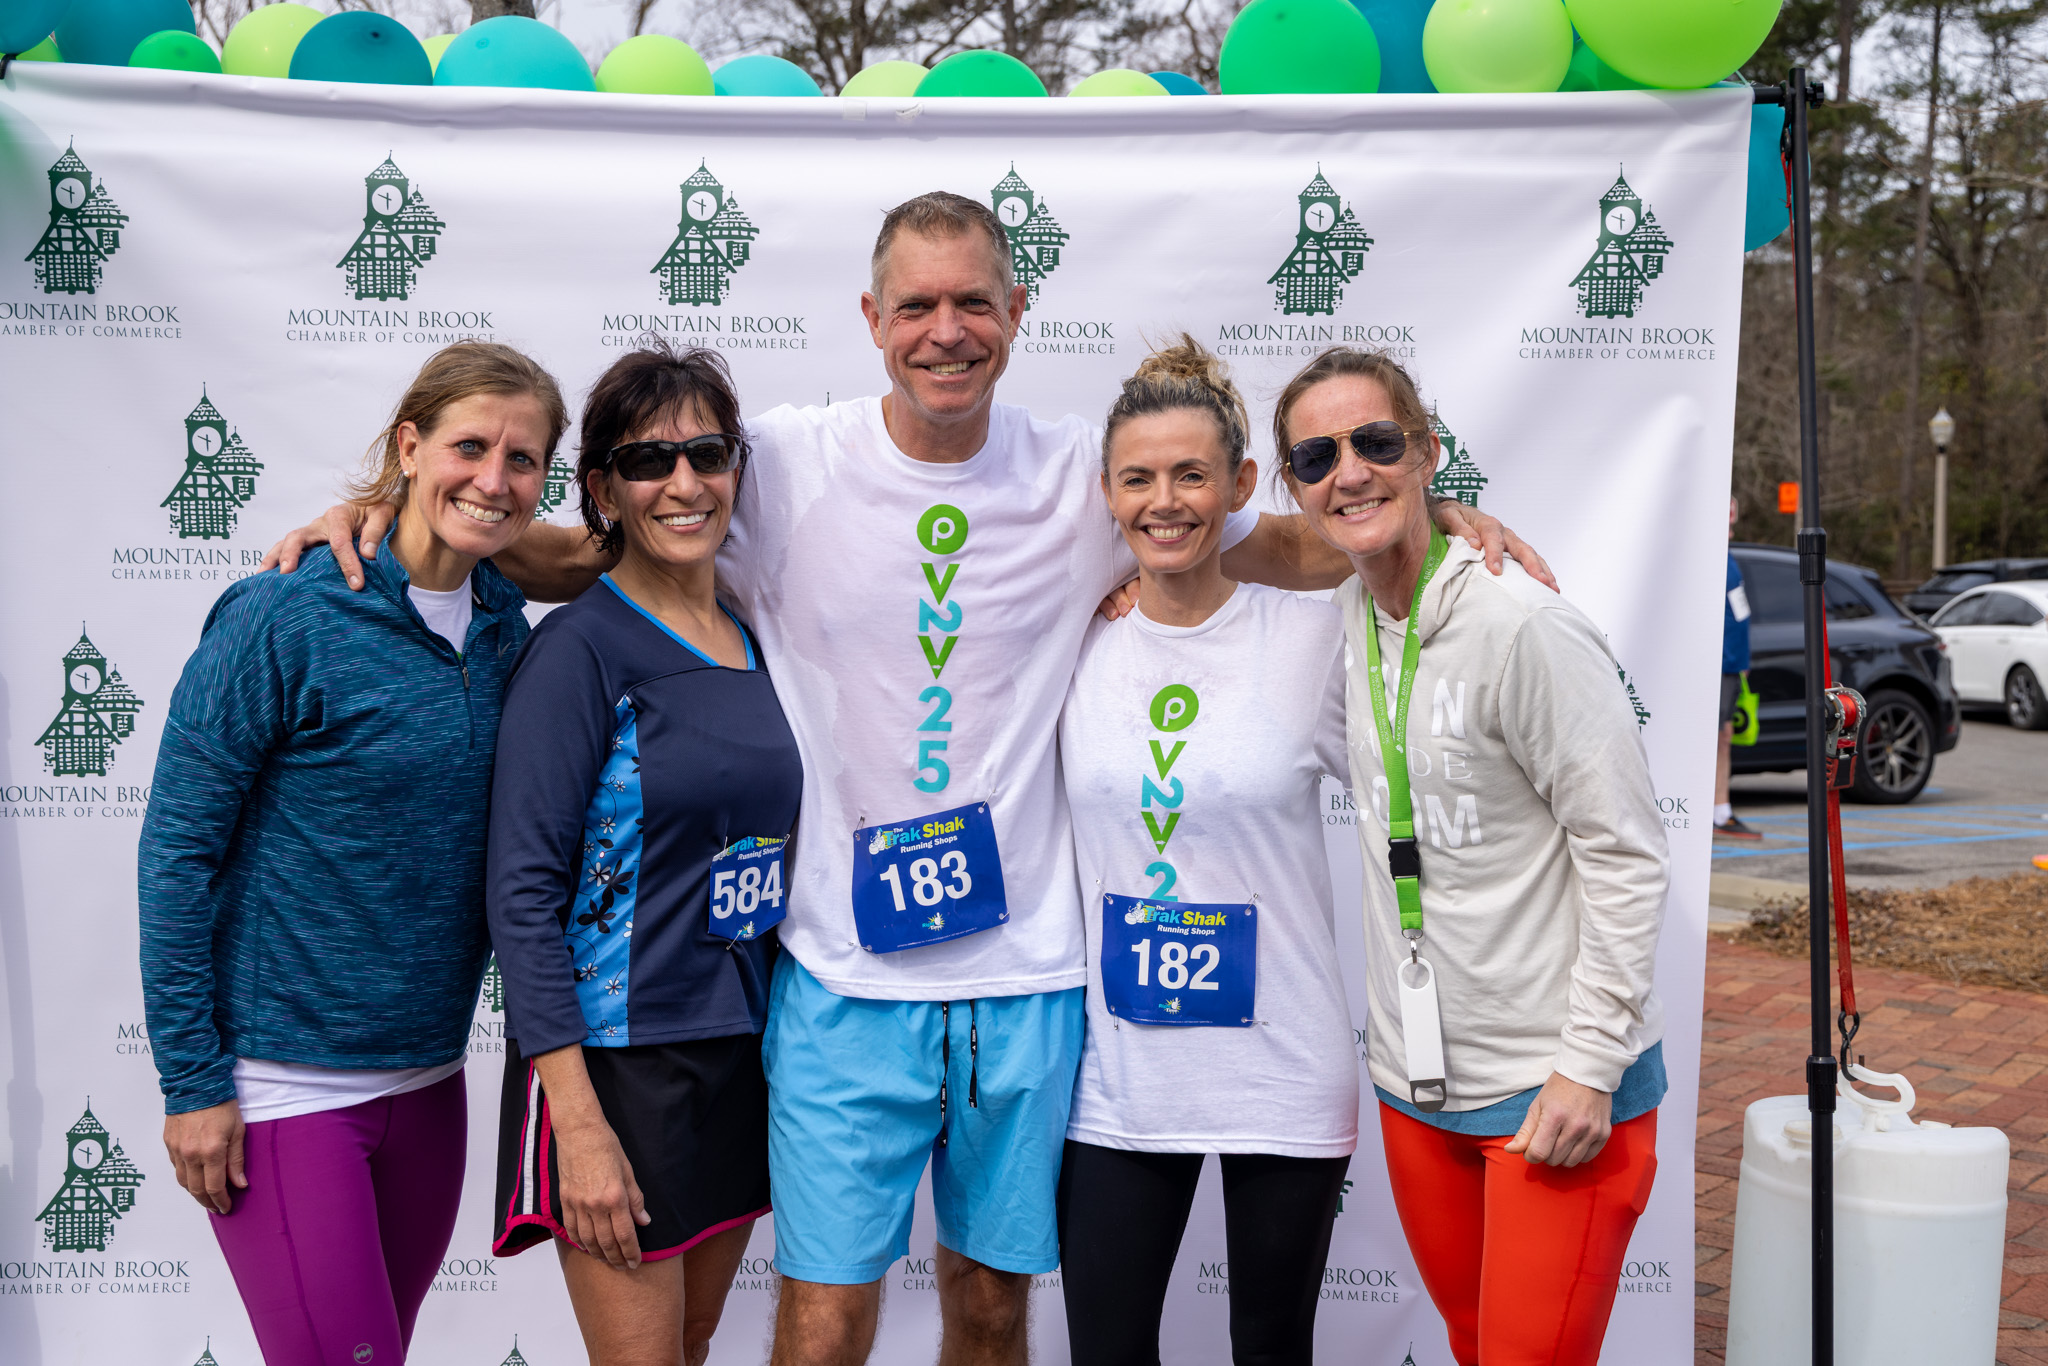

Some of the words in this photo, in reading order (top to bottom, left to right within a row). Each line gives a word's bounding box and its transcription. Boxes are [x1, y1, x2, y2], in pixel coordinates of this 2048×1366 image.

[0, 302, 97, 321] OUNTAIN
[106, 304, 180, 323] BROOK
[288, 309, 408, 327] MOUNTAIN
[418, 311, 495, 329] BROOK
[2, 324, 58, 336] AMBER
[65, 325, 85, 336] OF
[92, 325, 182, 338] COMMERCE
[602, 314, 721, 332] MOUNTAIN
[731, 316, 807, 334] BROOK
[1040, 321, 1115, 339] BROOK
[286, 330, 368, 342] CHAMBER
[375, 331, 395, 343] OF
[601, 335, 679, 347] CHAMER
[688, 336, 708, 348] OF
[716, 337, 808, 349] COMMERCE
[1218, 324, 1333, 341] MOUNTAIN
[1342, 325, 1416, 343] BROOK
[1520, 327, 1633, 344] MOUNTAIN
[1641, 328, 1716, 345] BROOK
[1024, 342, 1116, 354] COMMERCE
[1217, 345, 1294, 356] CHAMBER
[1300, 345, 1320, 356] OF
[1518, 348, 1594, 359] CHAMBER
[1600, 348, 1619, 360] OF
[1626, 349, 1716, 361] COMMERCE
[112, 547, 231, 565] MOUNTAIN
[112, 568, 192, 580] CHAMBER
[200, 569, 219, 580] OF
[0, 785, 107, 803] OUNTAIN
[0, 807, 66, 817] HAMBER
[73, 807, 94, 817] OF
[884, 827, 921, 846] Trak
[922, 817, 965, 838] Shak
[900, 841, 933, 853] Running
[934, 835, 958, 846] Shops
[738, 851, 762, 860] Running
[880, 850, 972, 912] 183
[713, 861, 783, 919] 584
[1145, 907, 1180, 924] Trak
[1182, 911, 1227, 926] Shak
[1157, 925, 1189, 935] Running
[1191, 928, 1215, 936] Shops
[1132, 938, 1220, 991] 182
[0, 1262, 105, 1279] OUNTAIN
[115, 1261, 190, 1278] BROOK
[436, 1259, 498, 1276] ROOK
[1620, 1262, 1671, 1277] OOK
[1324, 1267, 1399, 1287] BROOK
[0, 1283, 63, 1294] HAMBER
[71, 1283, 91, 1294] OF
[99, 1282, 190, 1294] COMMERCE
[431, 1281, 498, 1291] MMERCE
[1618, 1282, 1672, 1292] MERCE
[1319, 1289, 1399, 1303] OMMERCE
